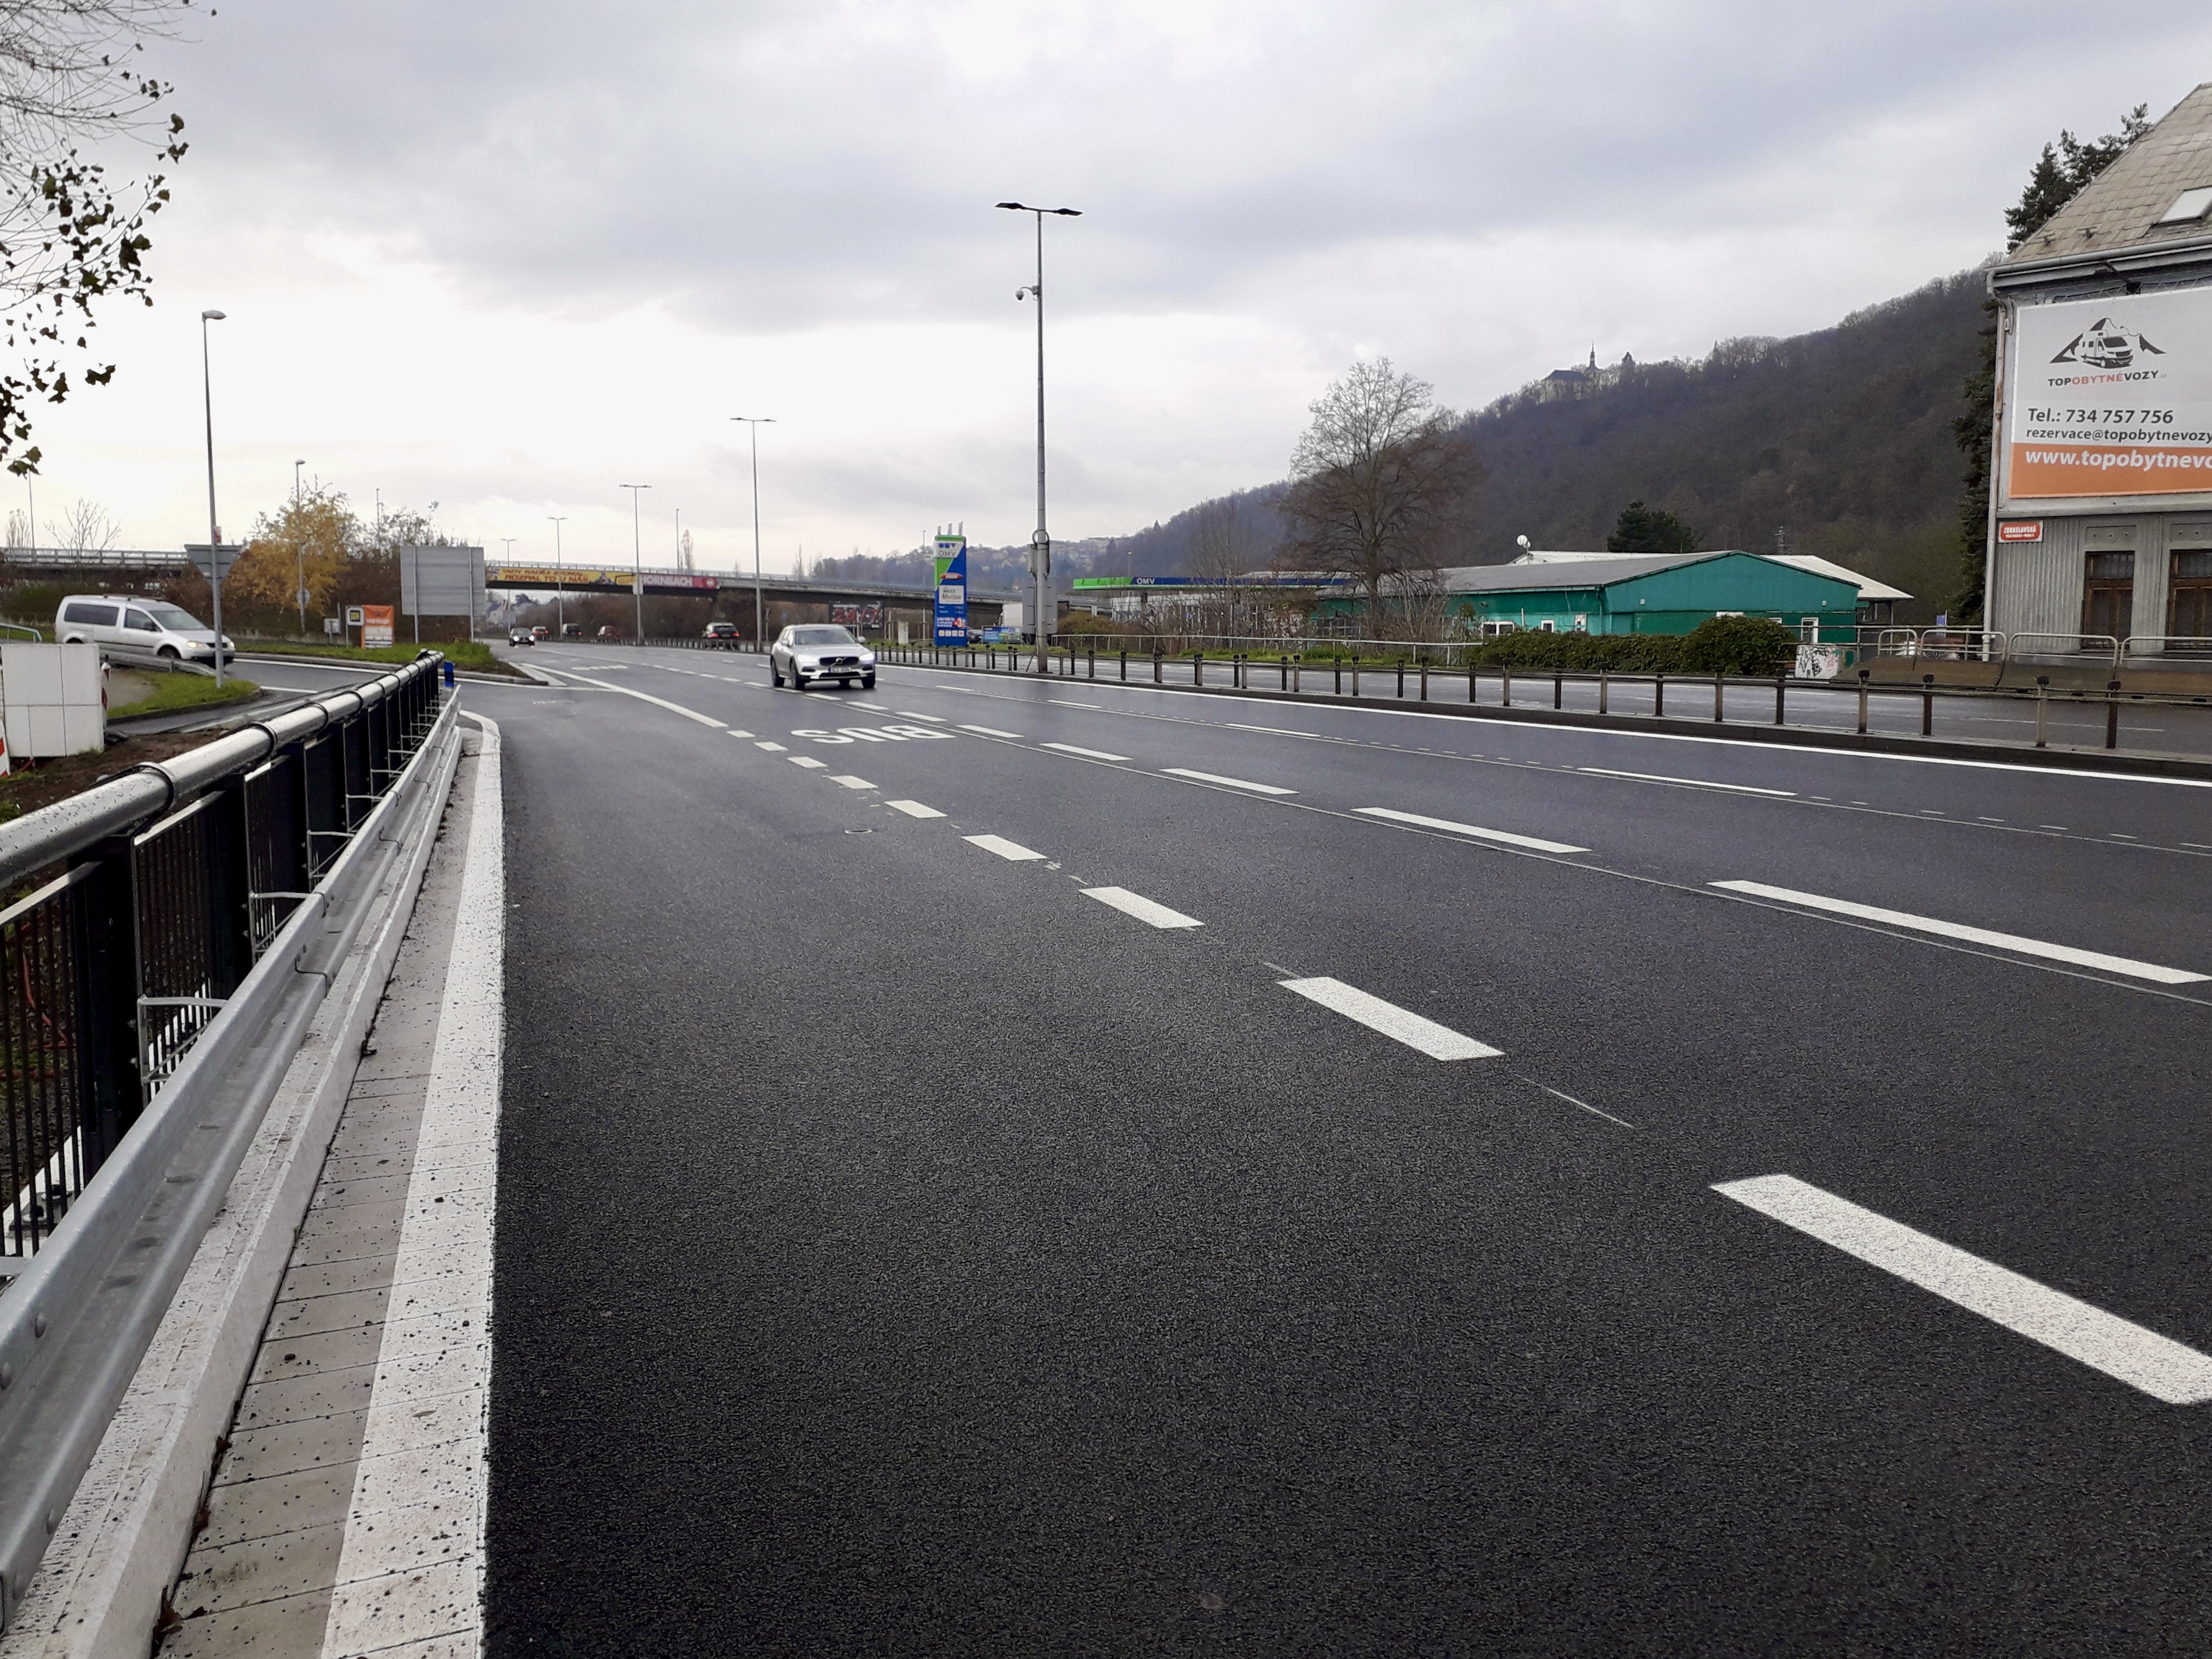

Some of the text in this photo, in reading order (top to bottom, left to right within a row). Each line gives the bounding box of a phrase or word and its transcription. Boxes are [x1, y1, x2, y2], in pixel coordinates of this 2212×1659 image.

[2048, 370, 2159, 386] TOPOBYTNÉVOZY
[2028, 408, 2174, 423] Tel.: 734 757 756
[640, 575, 693, 587] HORNBACH
[790, 725, 956, 743] BUS
